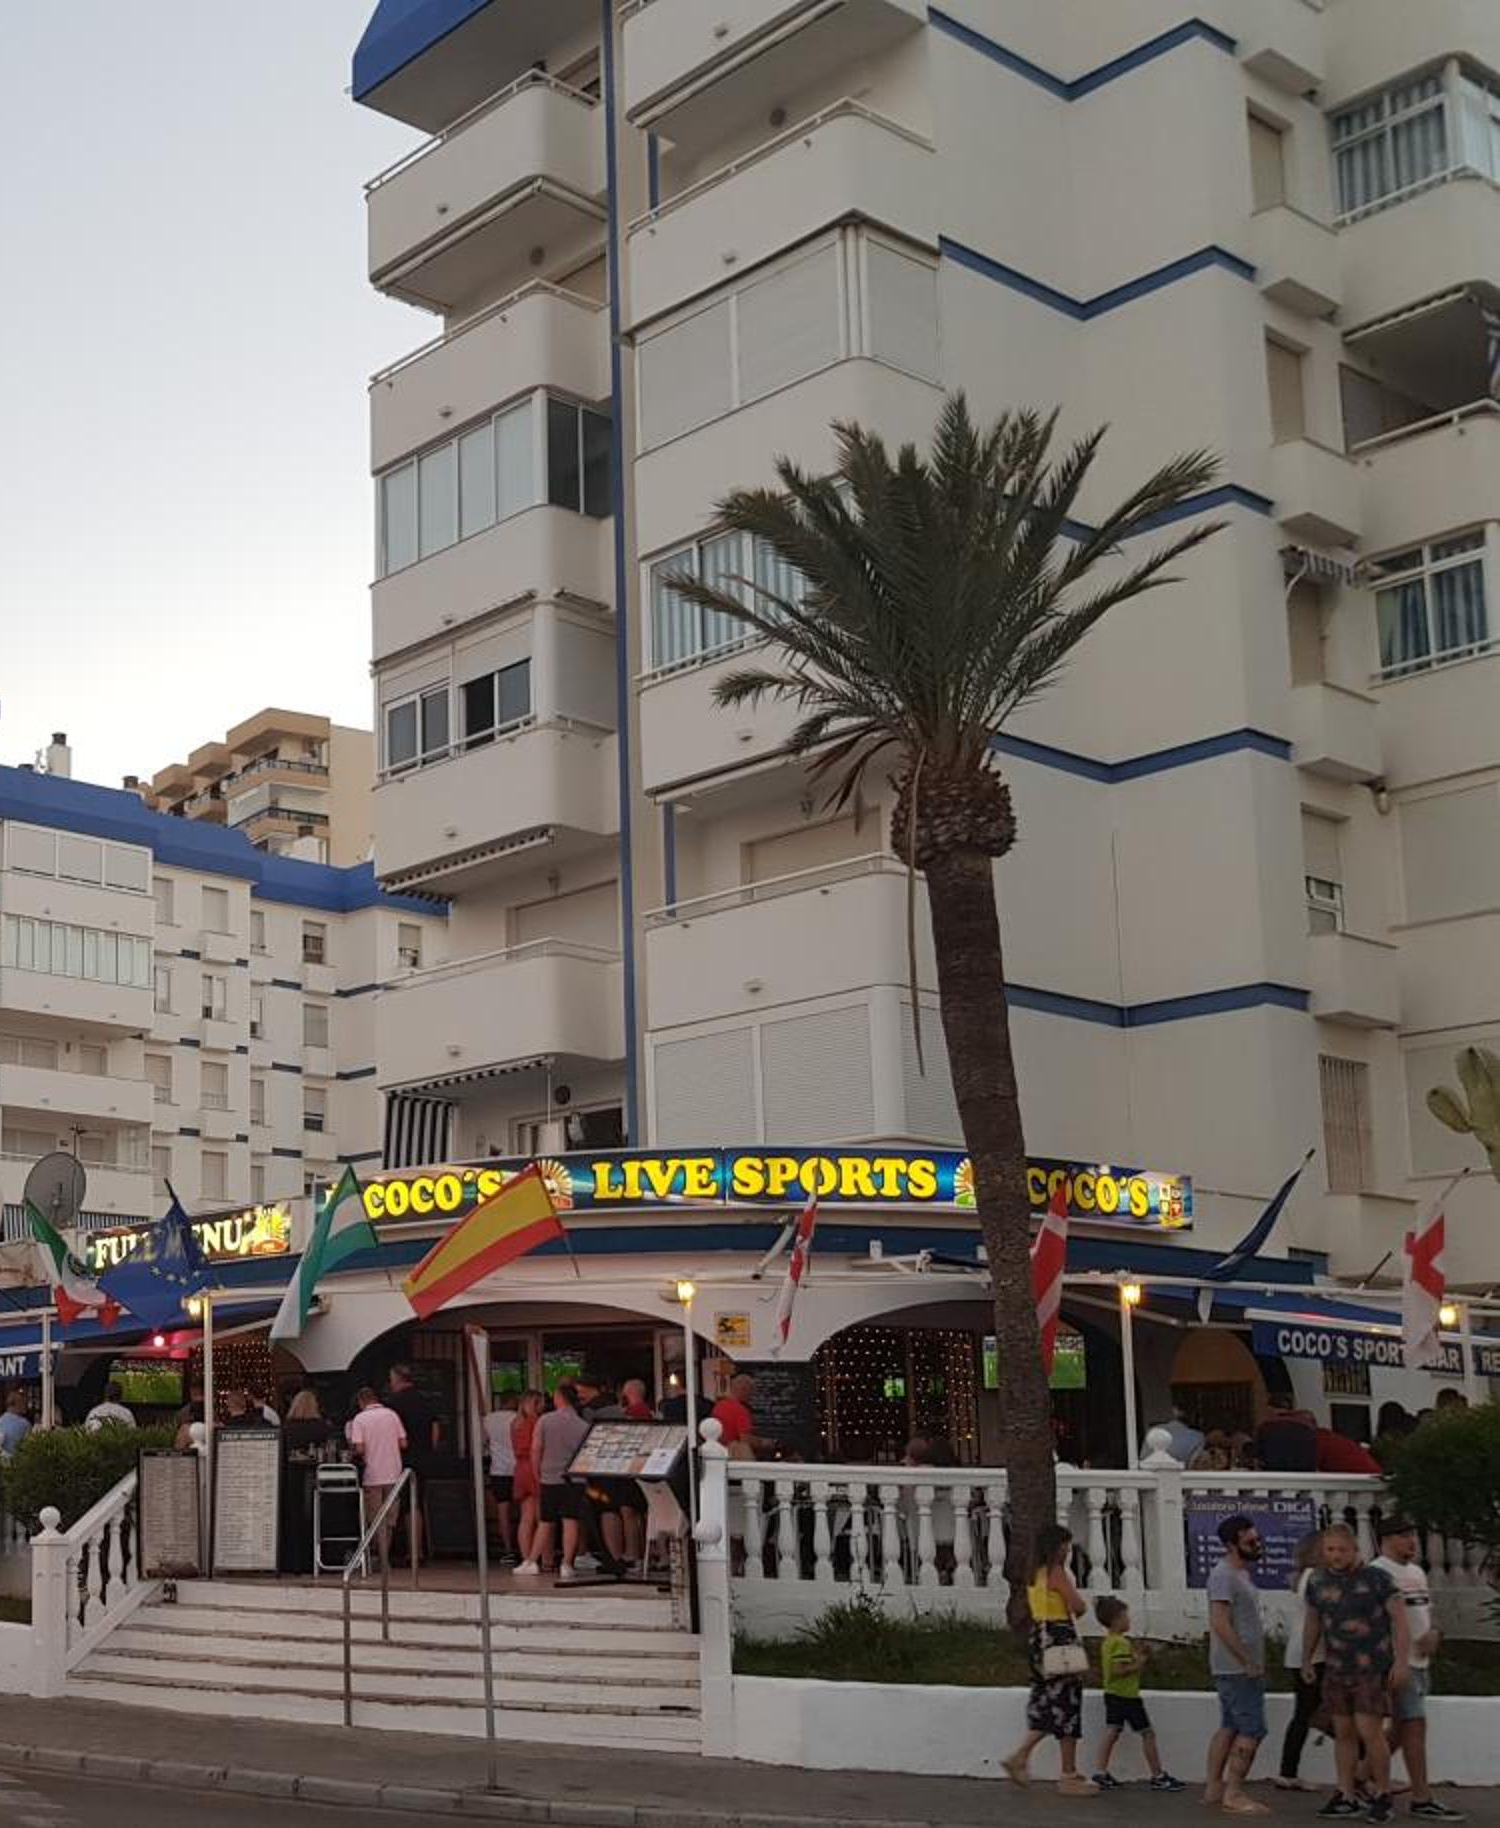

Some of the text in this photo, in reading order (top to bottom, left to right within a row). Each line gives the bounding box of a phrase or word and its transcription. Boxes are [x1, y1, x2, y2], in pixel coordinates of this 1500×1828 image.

[363, 1169, 501, 1219] COCO'S
[592, 1156, 937, 1199] LIVE SPORTS
[1027, 1167, 1148, 1217] COCO'S
[1277, 1329, 1348, 1359] COCO'S
